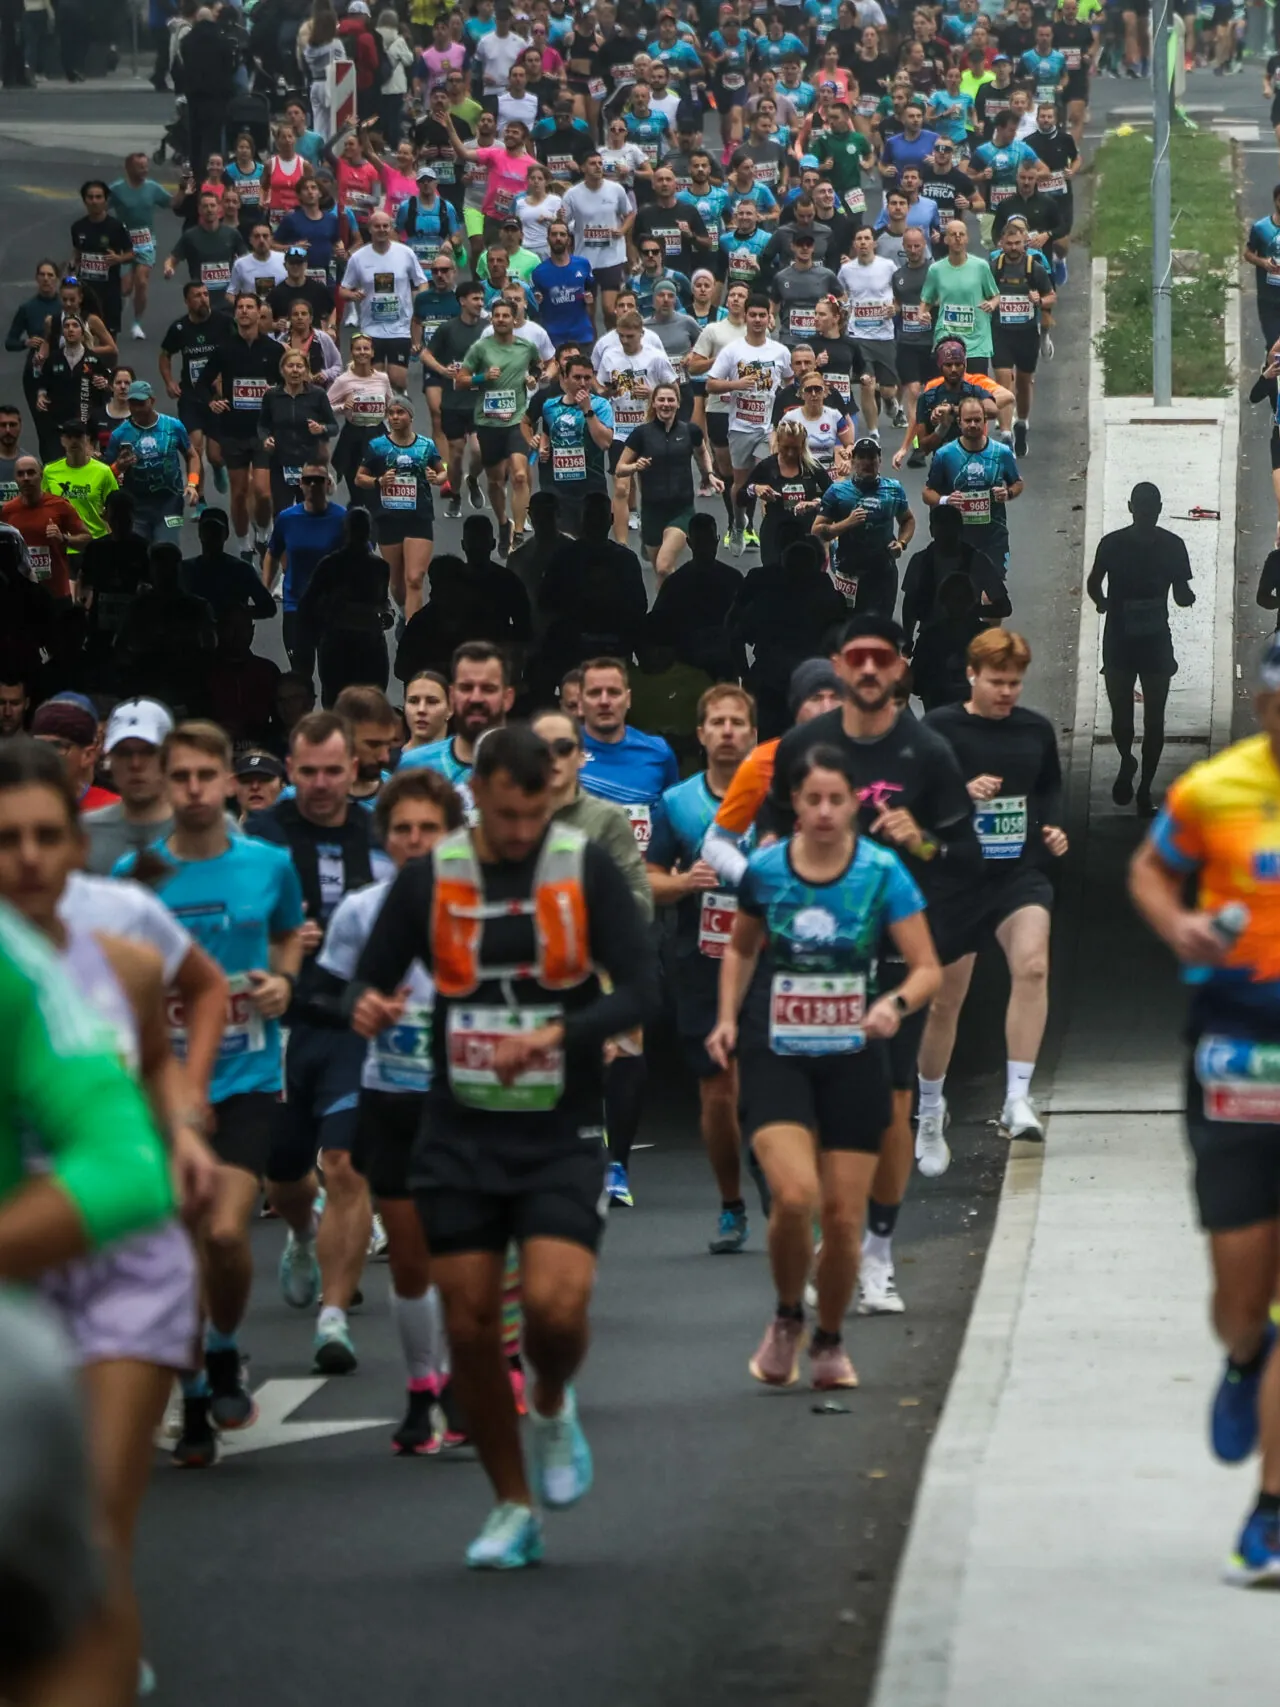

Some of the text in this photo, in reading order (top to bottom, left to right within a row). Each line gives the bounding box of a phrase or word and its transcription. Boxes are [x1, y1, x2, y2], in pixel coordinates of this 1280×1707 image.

[922, 188, 955, 199] STRICA
[956, 310, 973, 322] 1841
[80, 377, 90, 401] TEAM
[555, 455, 584, 467] C12368
[386, 485, 415, 497] C13038
[969, 499, 989, 512] 9685
[973, 817, 985, 834] C
